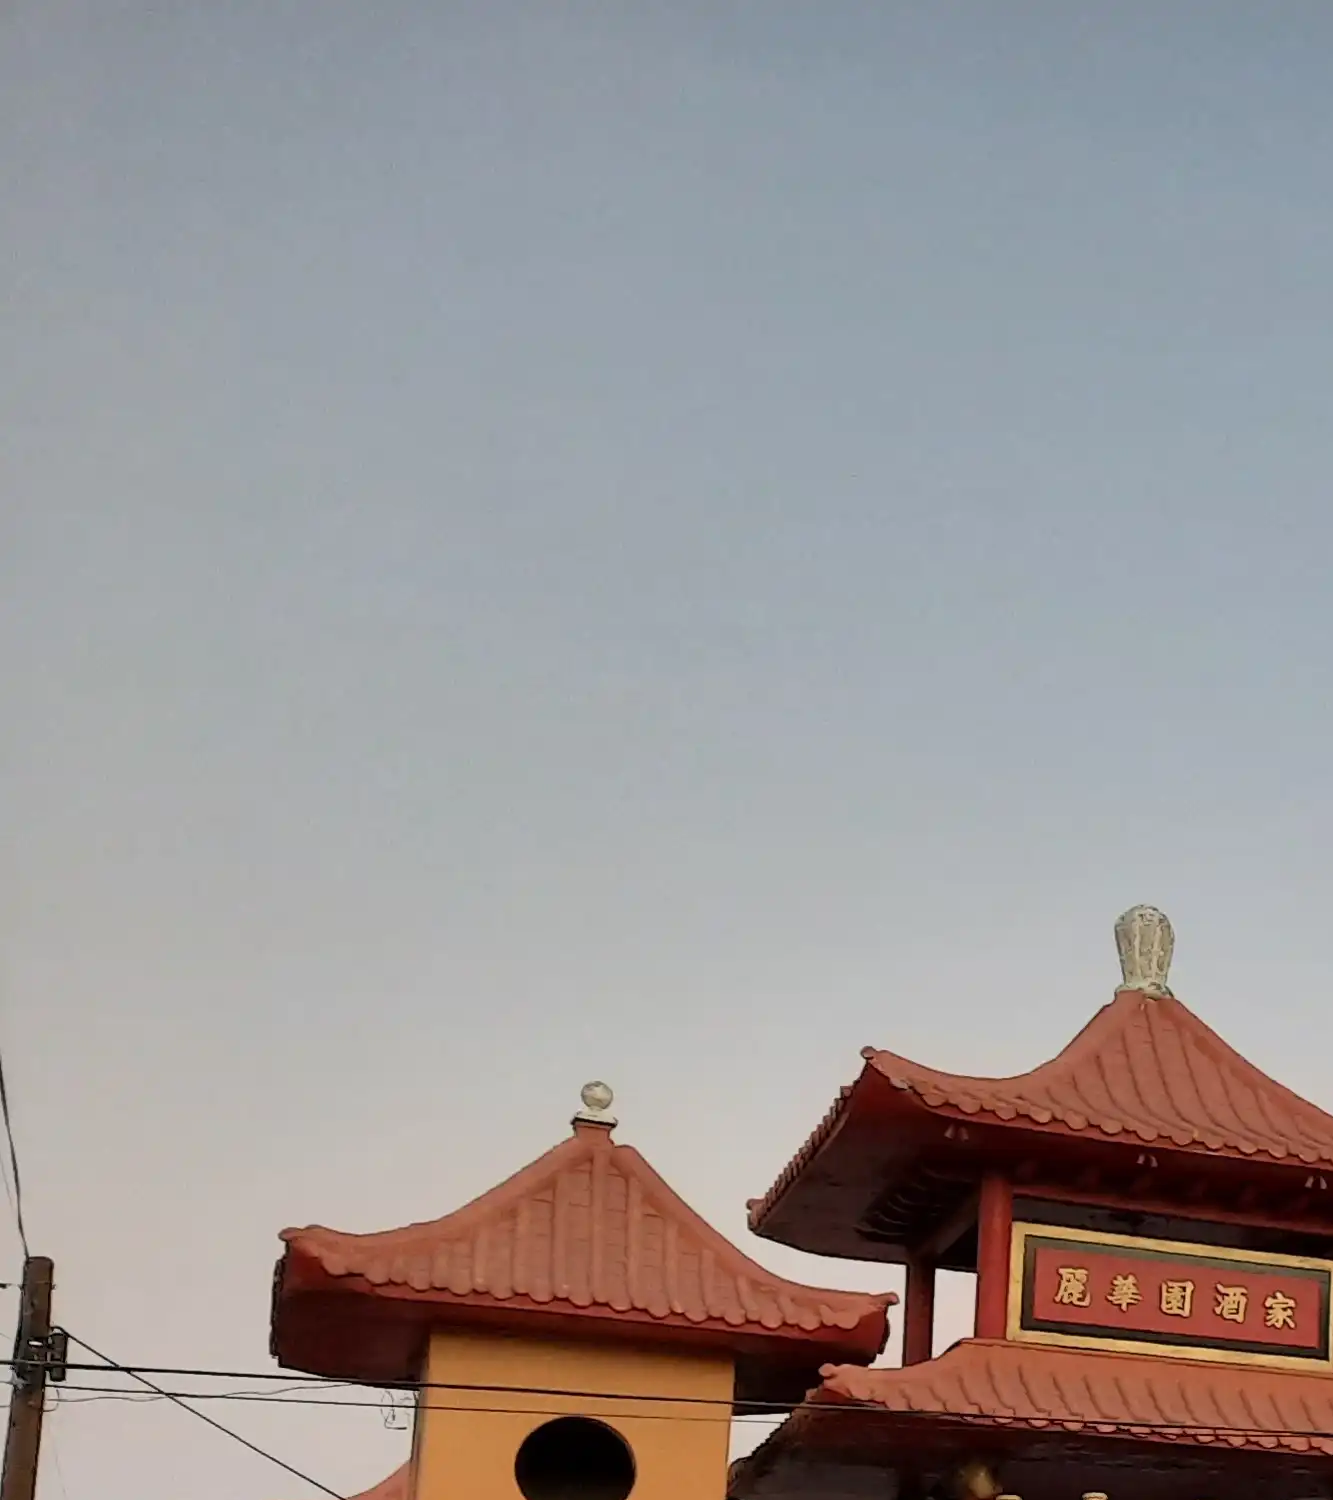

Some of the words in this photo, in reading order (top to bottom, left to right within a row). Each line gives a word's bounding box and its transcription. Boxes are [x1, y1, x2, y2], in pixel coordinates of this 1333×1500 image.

[1054, 1267, 1297, 1330] 麗華園酒家
